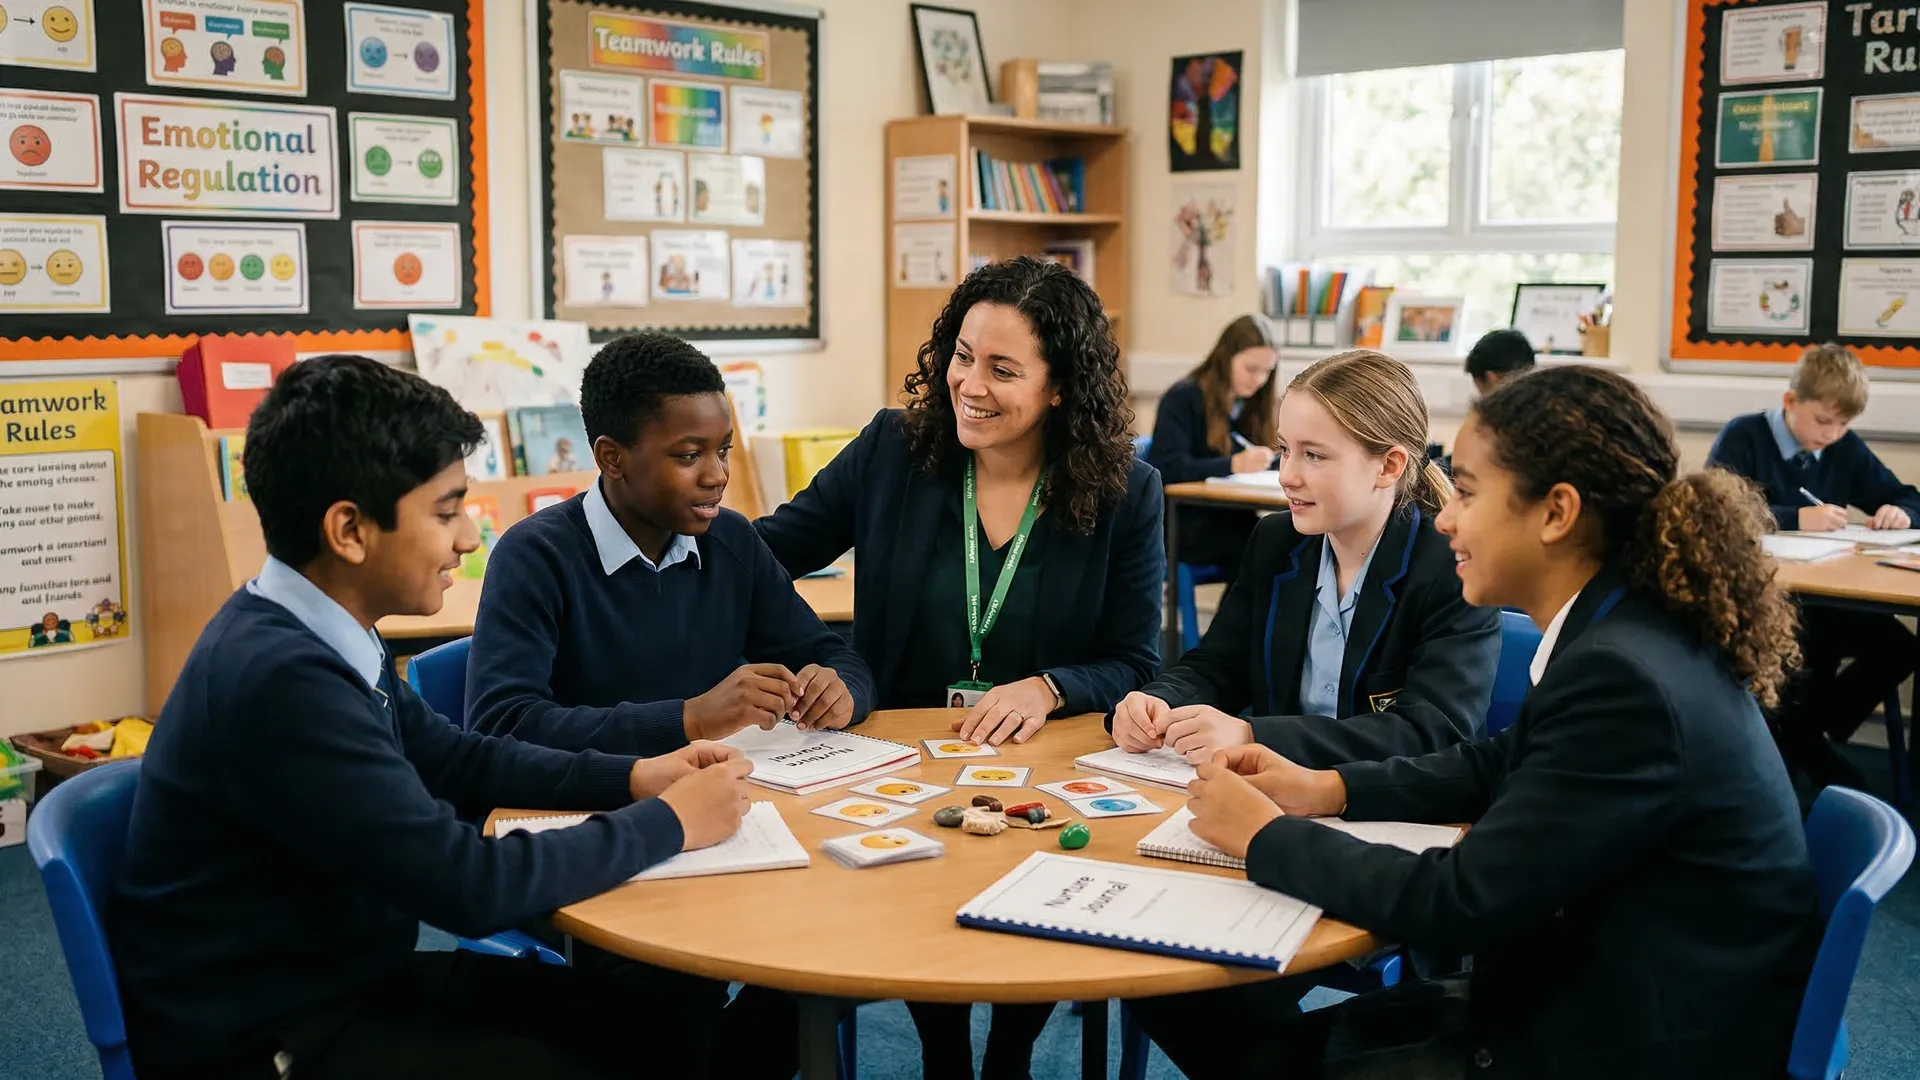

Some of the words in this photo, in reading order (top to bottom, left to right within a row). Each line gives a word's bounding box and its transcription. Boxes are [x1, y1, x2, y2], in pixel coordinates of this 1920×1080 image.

[1845, 2, 1920, 36] Tar
[595, 27, 705, 62] Teamwork
[711, 41, 764, 68] Rules
[1864, 40, 1920, 75] Ru
[141, 116, 316, 153] Emotional
[139, 159, 322, 200] Regulation
[6, 419, 76, 442] Rules
[768, 743, 834, 763] Journal
[786, 747, 854, 767] Nurture
[1043, 876, 1094, 907] Nurture
[1080, 880, 1129, 914] Journal
